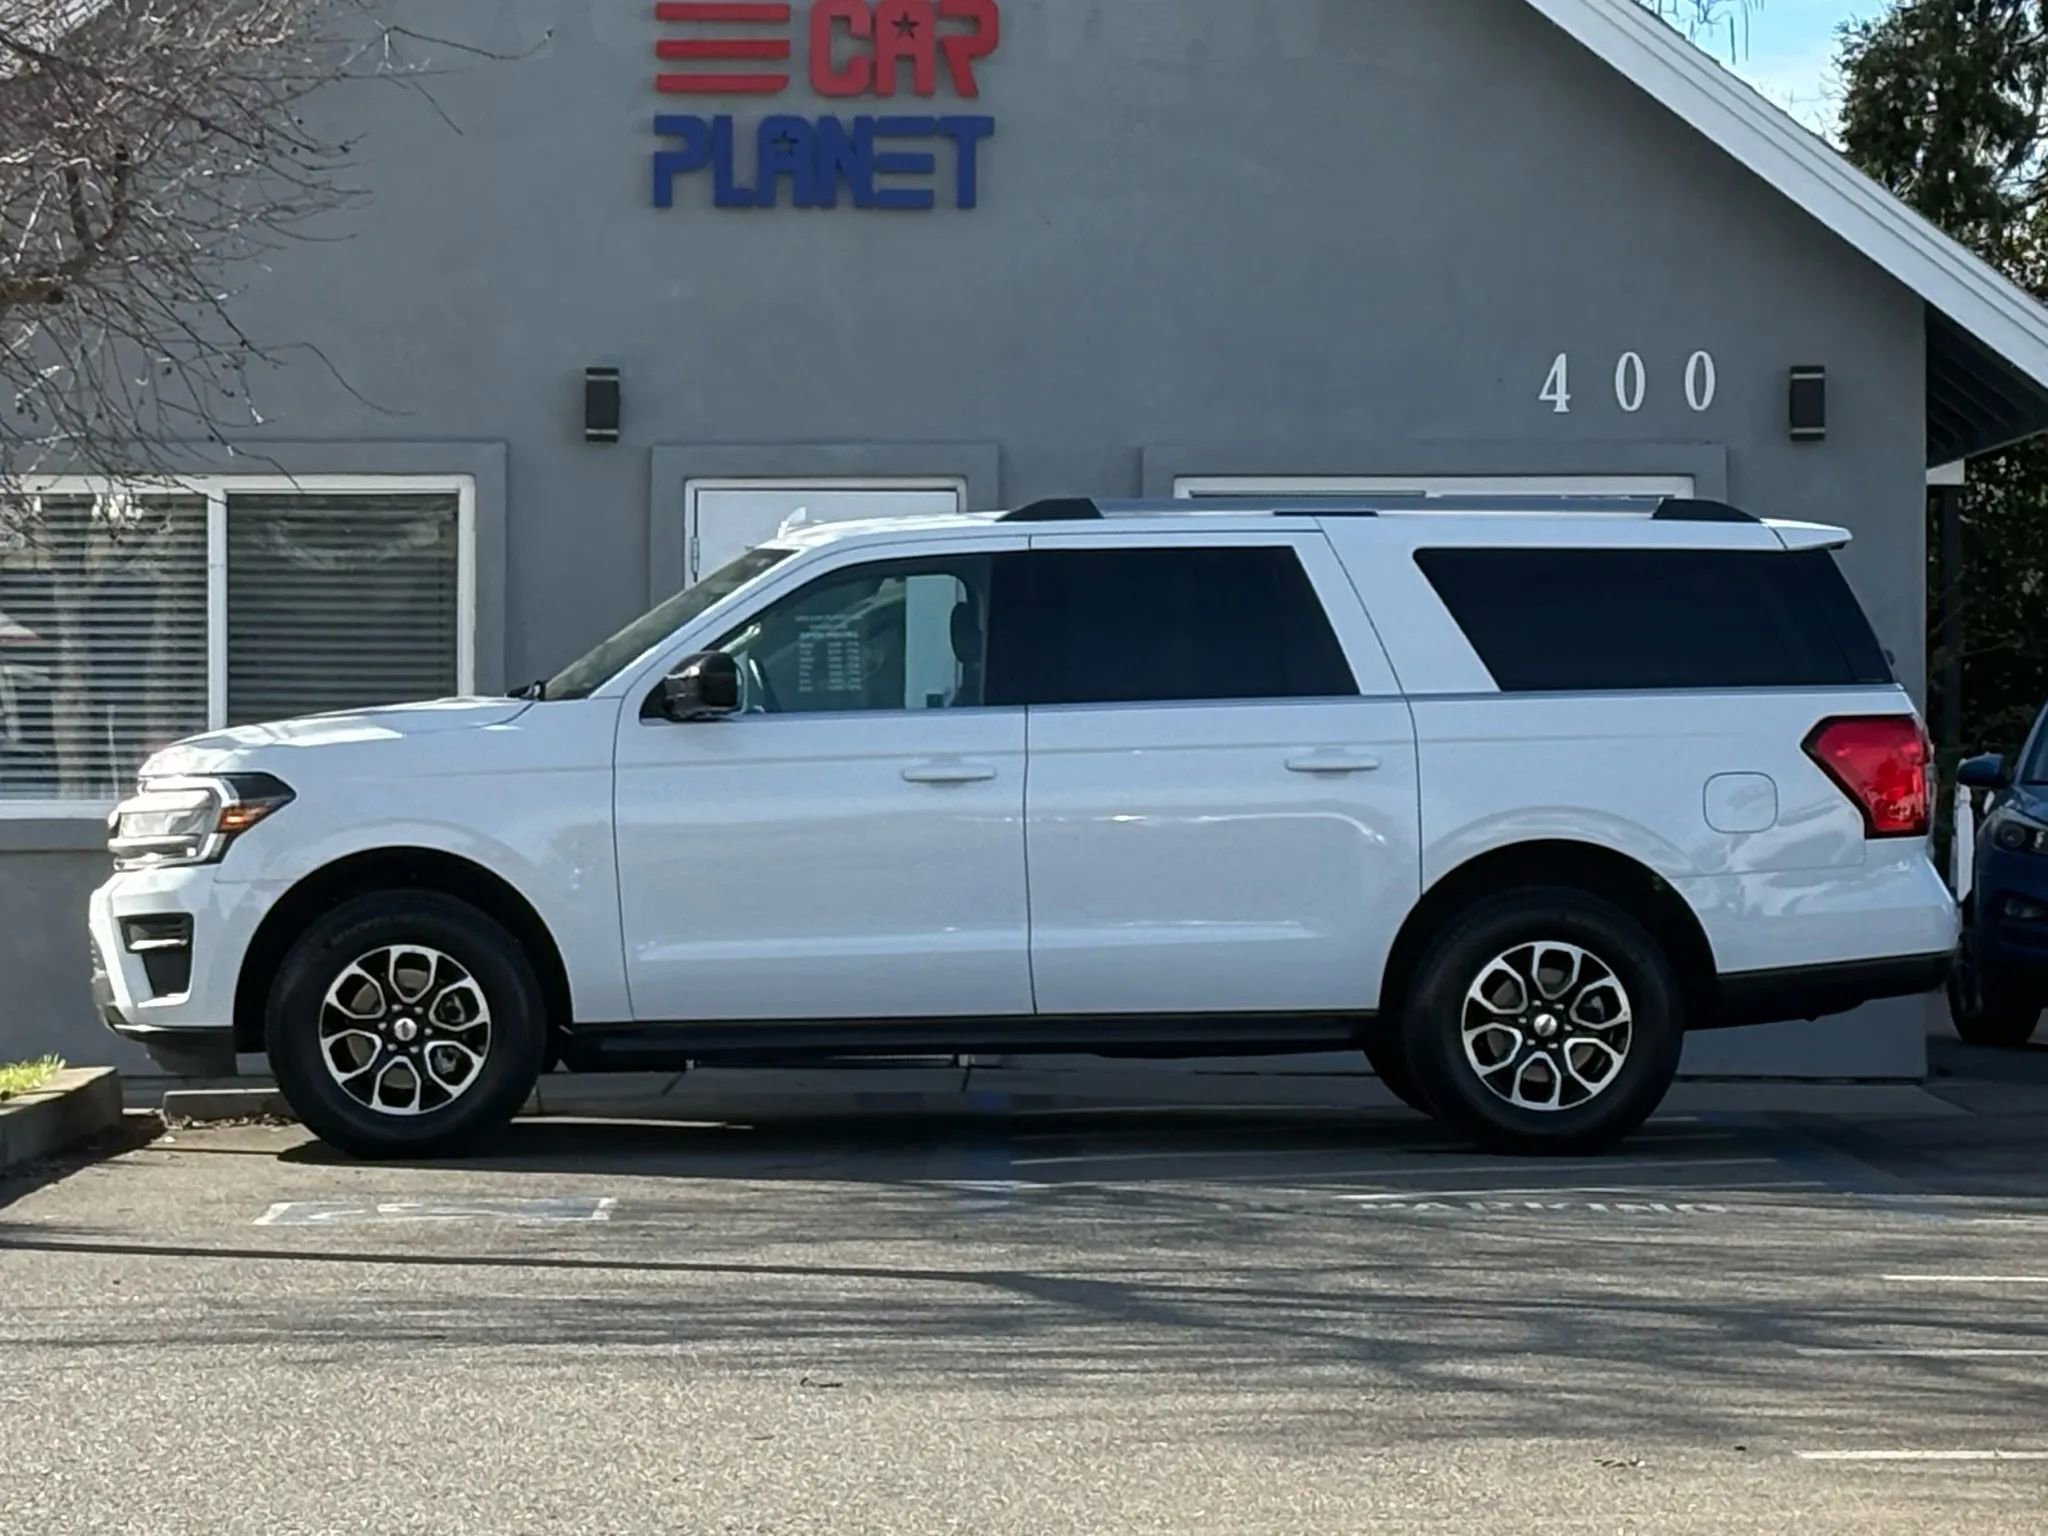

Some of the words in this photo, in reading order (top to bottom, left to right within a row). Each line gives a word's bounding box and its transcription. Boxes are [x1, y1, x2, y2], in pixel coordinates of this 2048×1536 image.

[810, 0, 999, 97] CAR
[653, 115, 995, 209] PLANET
[1538, 350, 1716, 413] 400
